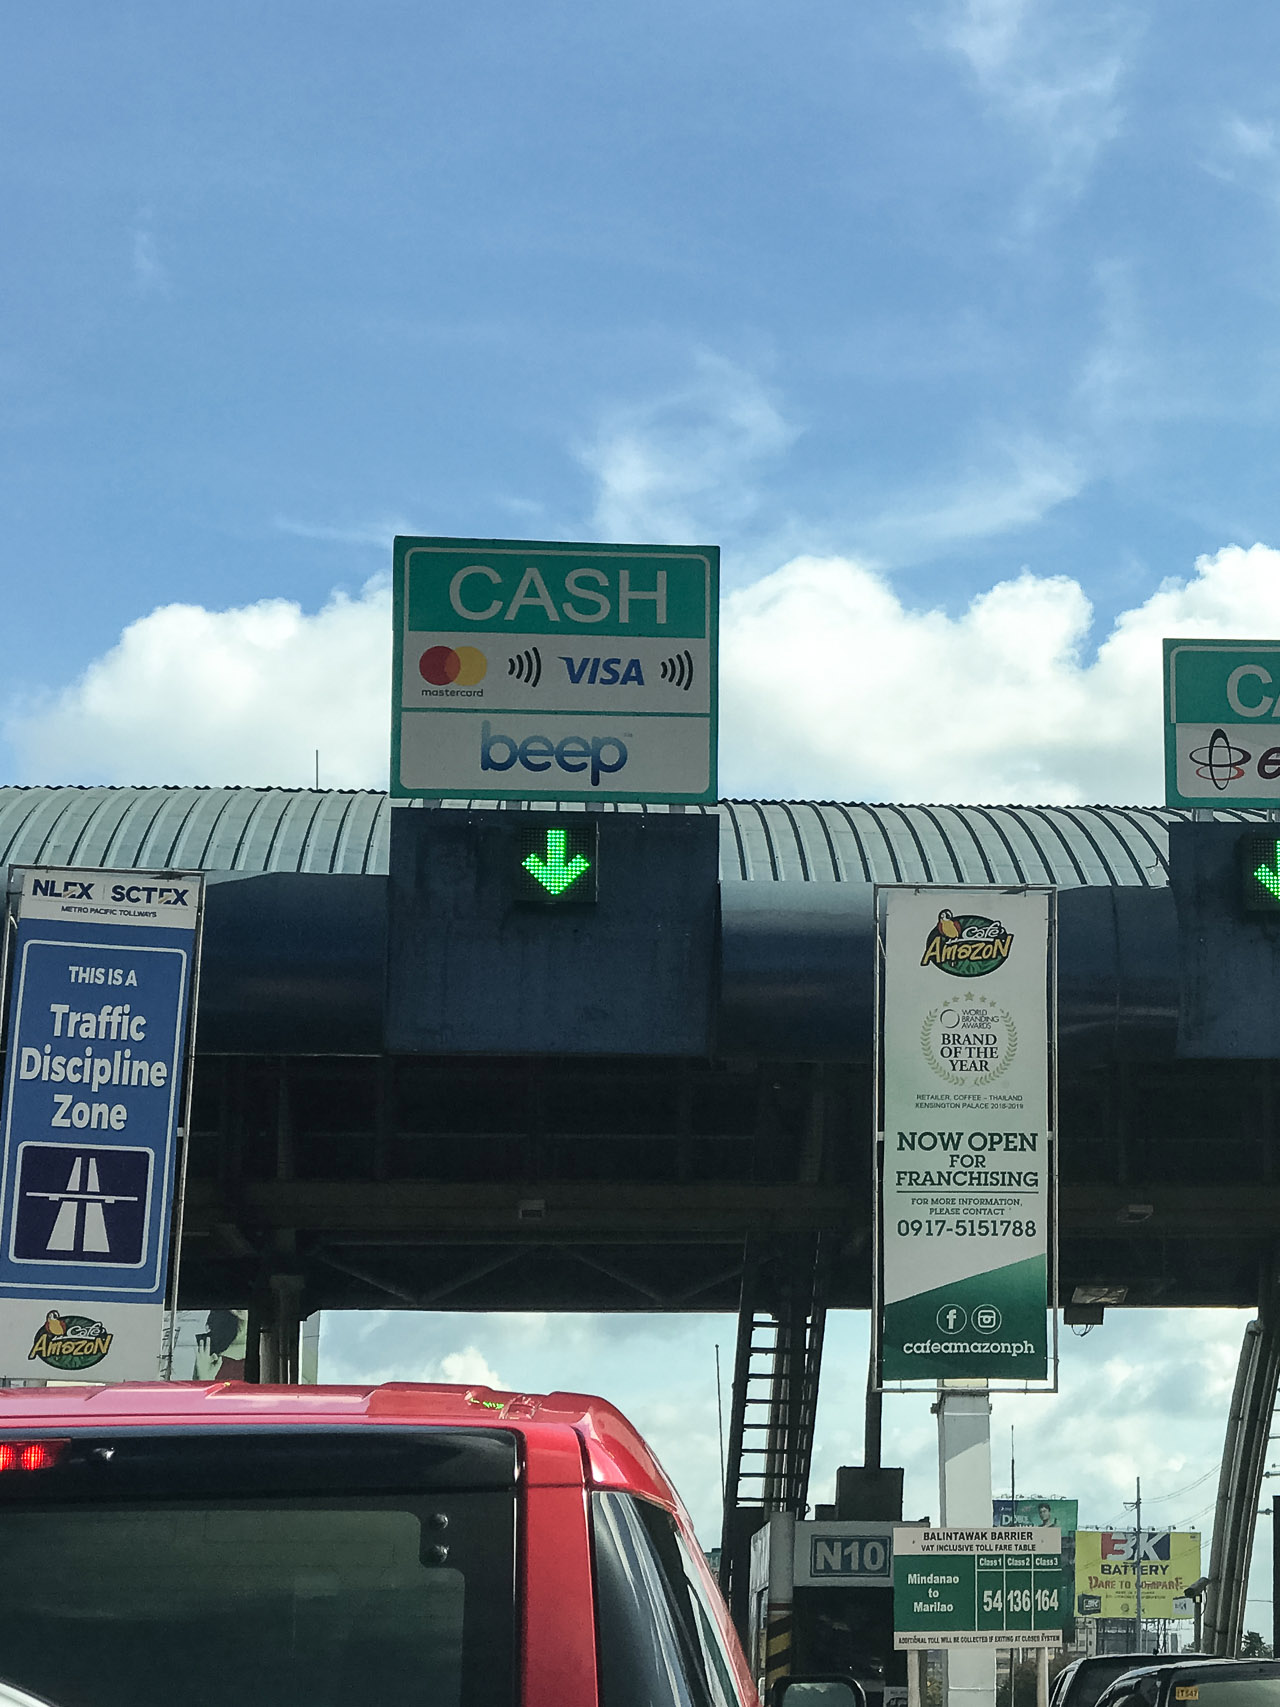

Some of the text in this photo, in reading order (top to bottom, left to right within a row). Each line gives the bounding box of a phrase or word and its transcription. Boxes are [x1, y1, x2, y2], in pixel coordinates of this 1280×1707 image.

[449, 565, 667, 625] CASH
[557, 656, 645, 686] VISA
[421, 688, 484, 698] mastercard
[480, 719, 628, 787] beep
[32, 879, 189, 906] NLEX SCTEX
[61, 905, 157, 918] METRO PACIFIC TOLLWAYS
[69, 966, 138, 987] THIS IS A
[50, 1003, 147, 1042] Traffic
[941, 1034, 997, 1045] BRAND
[940, 1047, 999, 1058] OF THE
[19, 1044, 168, 1093] Discipline
[949, 1060, 990, 1072] YEAR
[51, 1094, 128, 1130] Zone
[896, 1132, 1038, 1152] NOW OPEN
[949, 1154, 986, 1168] FOR
[896, 1171, 1039, 1187] FRANCHISING
[958, 1198, 1023, 1207] INFORMATION,
[963, 1208, 1005, 1216] CONTACT
[897, 1219, 1037, 1237] 0917-5151788
[903, 1339, 1035, 1357] cafeamazonph
[923, 1531, 1033, 1541] BALINTAWAK BARRIER
[936, 1544, 974, 1552] INCLUSIVE
[1107, 1533, 1168, 1561] 3K
[816, 1541, 885, 1571] N10
[1101, 1564, 1170, 1575] BATTERY
[907, 1574, 959, 1584] Mindanao
[1088, 1576, 1116, 1591] DARE
[1119, 1581, 1131, 1589] TO
[928, 1588, 939, 1598] to
[983, 1590, 1003, 1612] 54
[1007, 1589, 1031, 1612] 136
[1035, 1589, 1059, 1612] 164
[913, 1602, 954, 1612] Marilao
[898, 1635, 926, 1644] ADDITIONAL
[994, 1635, 1013, 1643] EXITING
[1041, 1633, 1060, 1642] SYSTEM
